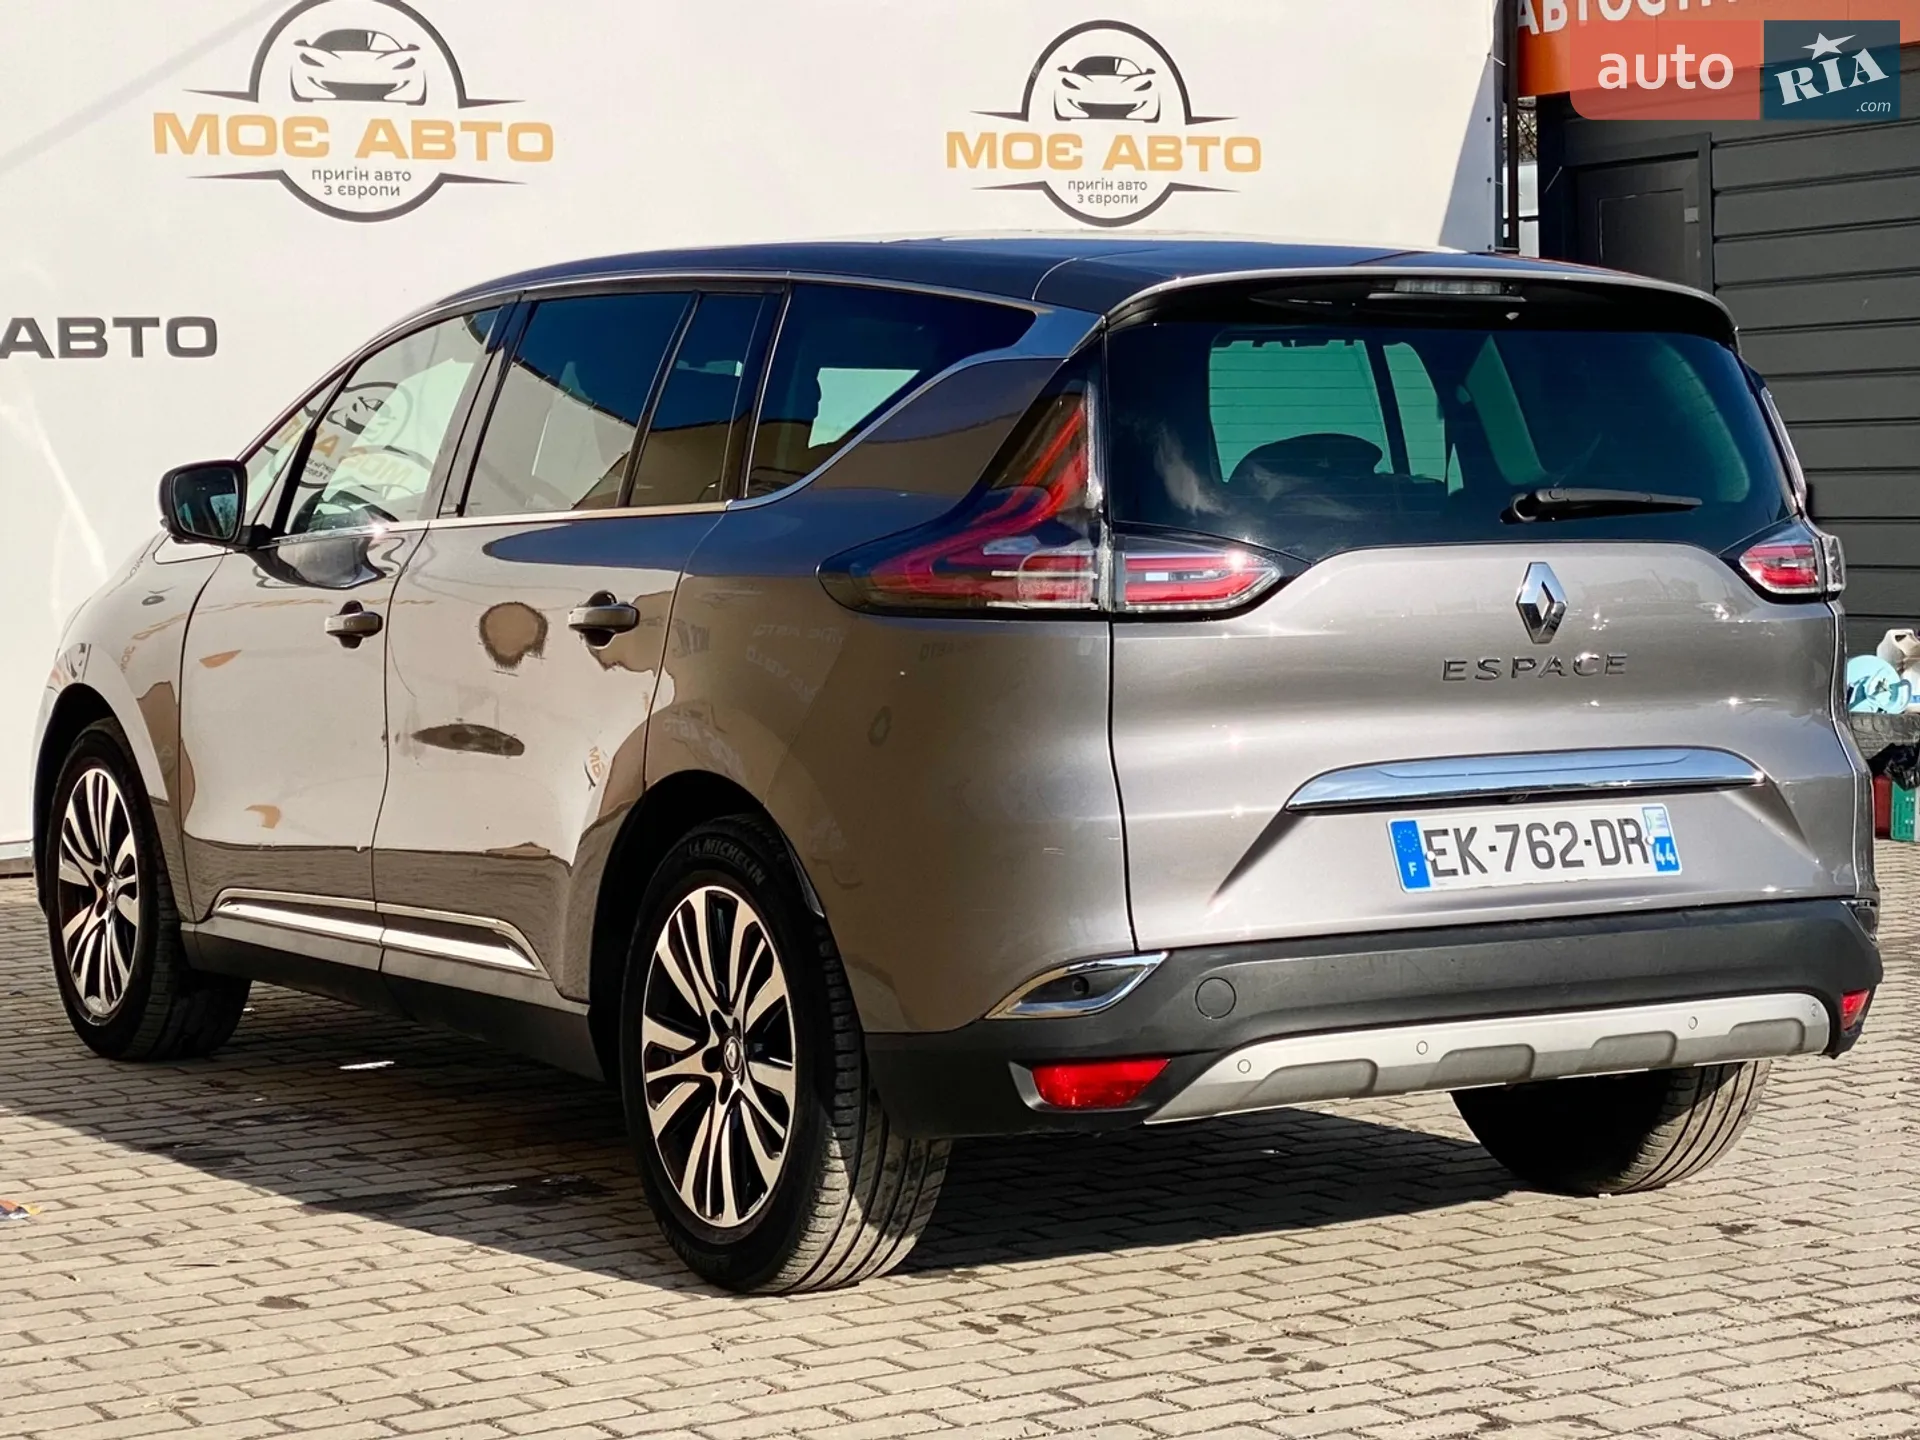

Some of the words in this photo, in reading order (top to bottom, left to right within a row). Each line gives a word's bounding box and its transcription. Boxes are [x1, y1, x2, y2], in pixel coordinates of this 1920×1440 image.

[152, 112, 330, 158] МОЄ
[355, 117, 555, 163] АВТО
[945, 131, 1084, 171] МОЄ
[1102, 134, 1263, 174] АВТО
[311, 166, 369, 183] пригін
[374, 170, 412, 182] авто
[337, 185, 401, 199] європи
[1067, 178, 1114, 193] пригін
[1117, 181, 1148, 191] авто
[1087, 194, 1138, 207] європи
[0, 317, 218, 359] АВТО
[1443, 653, 1628, 682] ESPACE
[702, 837, 767, 887] MICHELIN
[1407, 861, 1418, 878] F
[1423, 818, 1650, 878] EK-762-DR
[1655, 842, 1676, 866] 44
